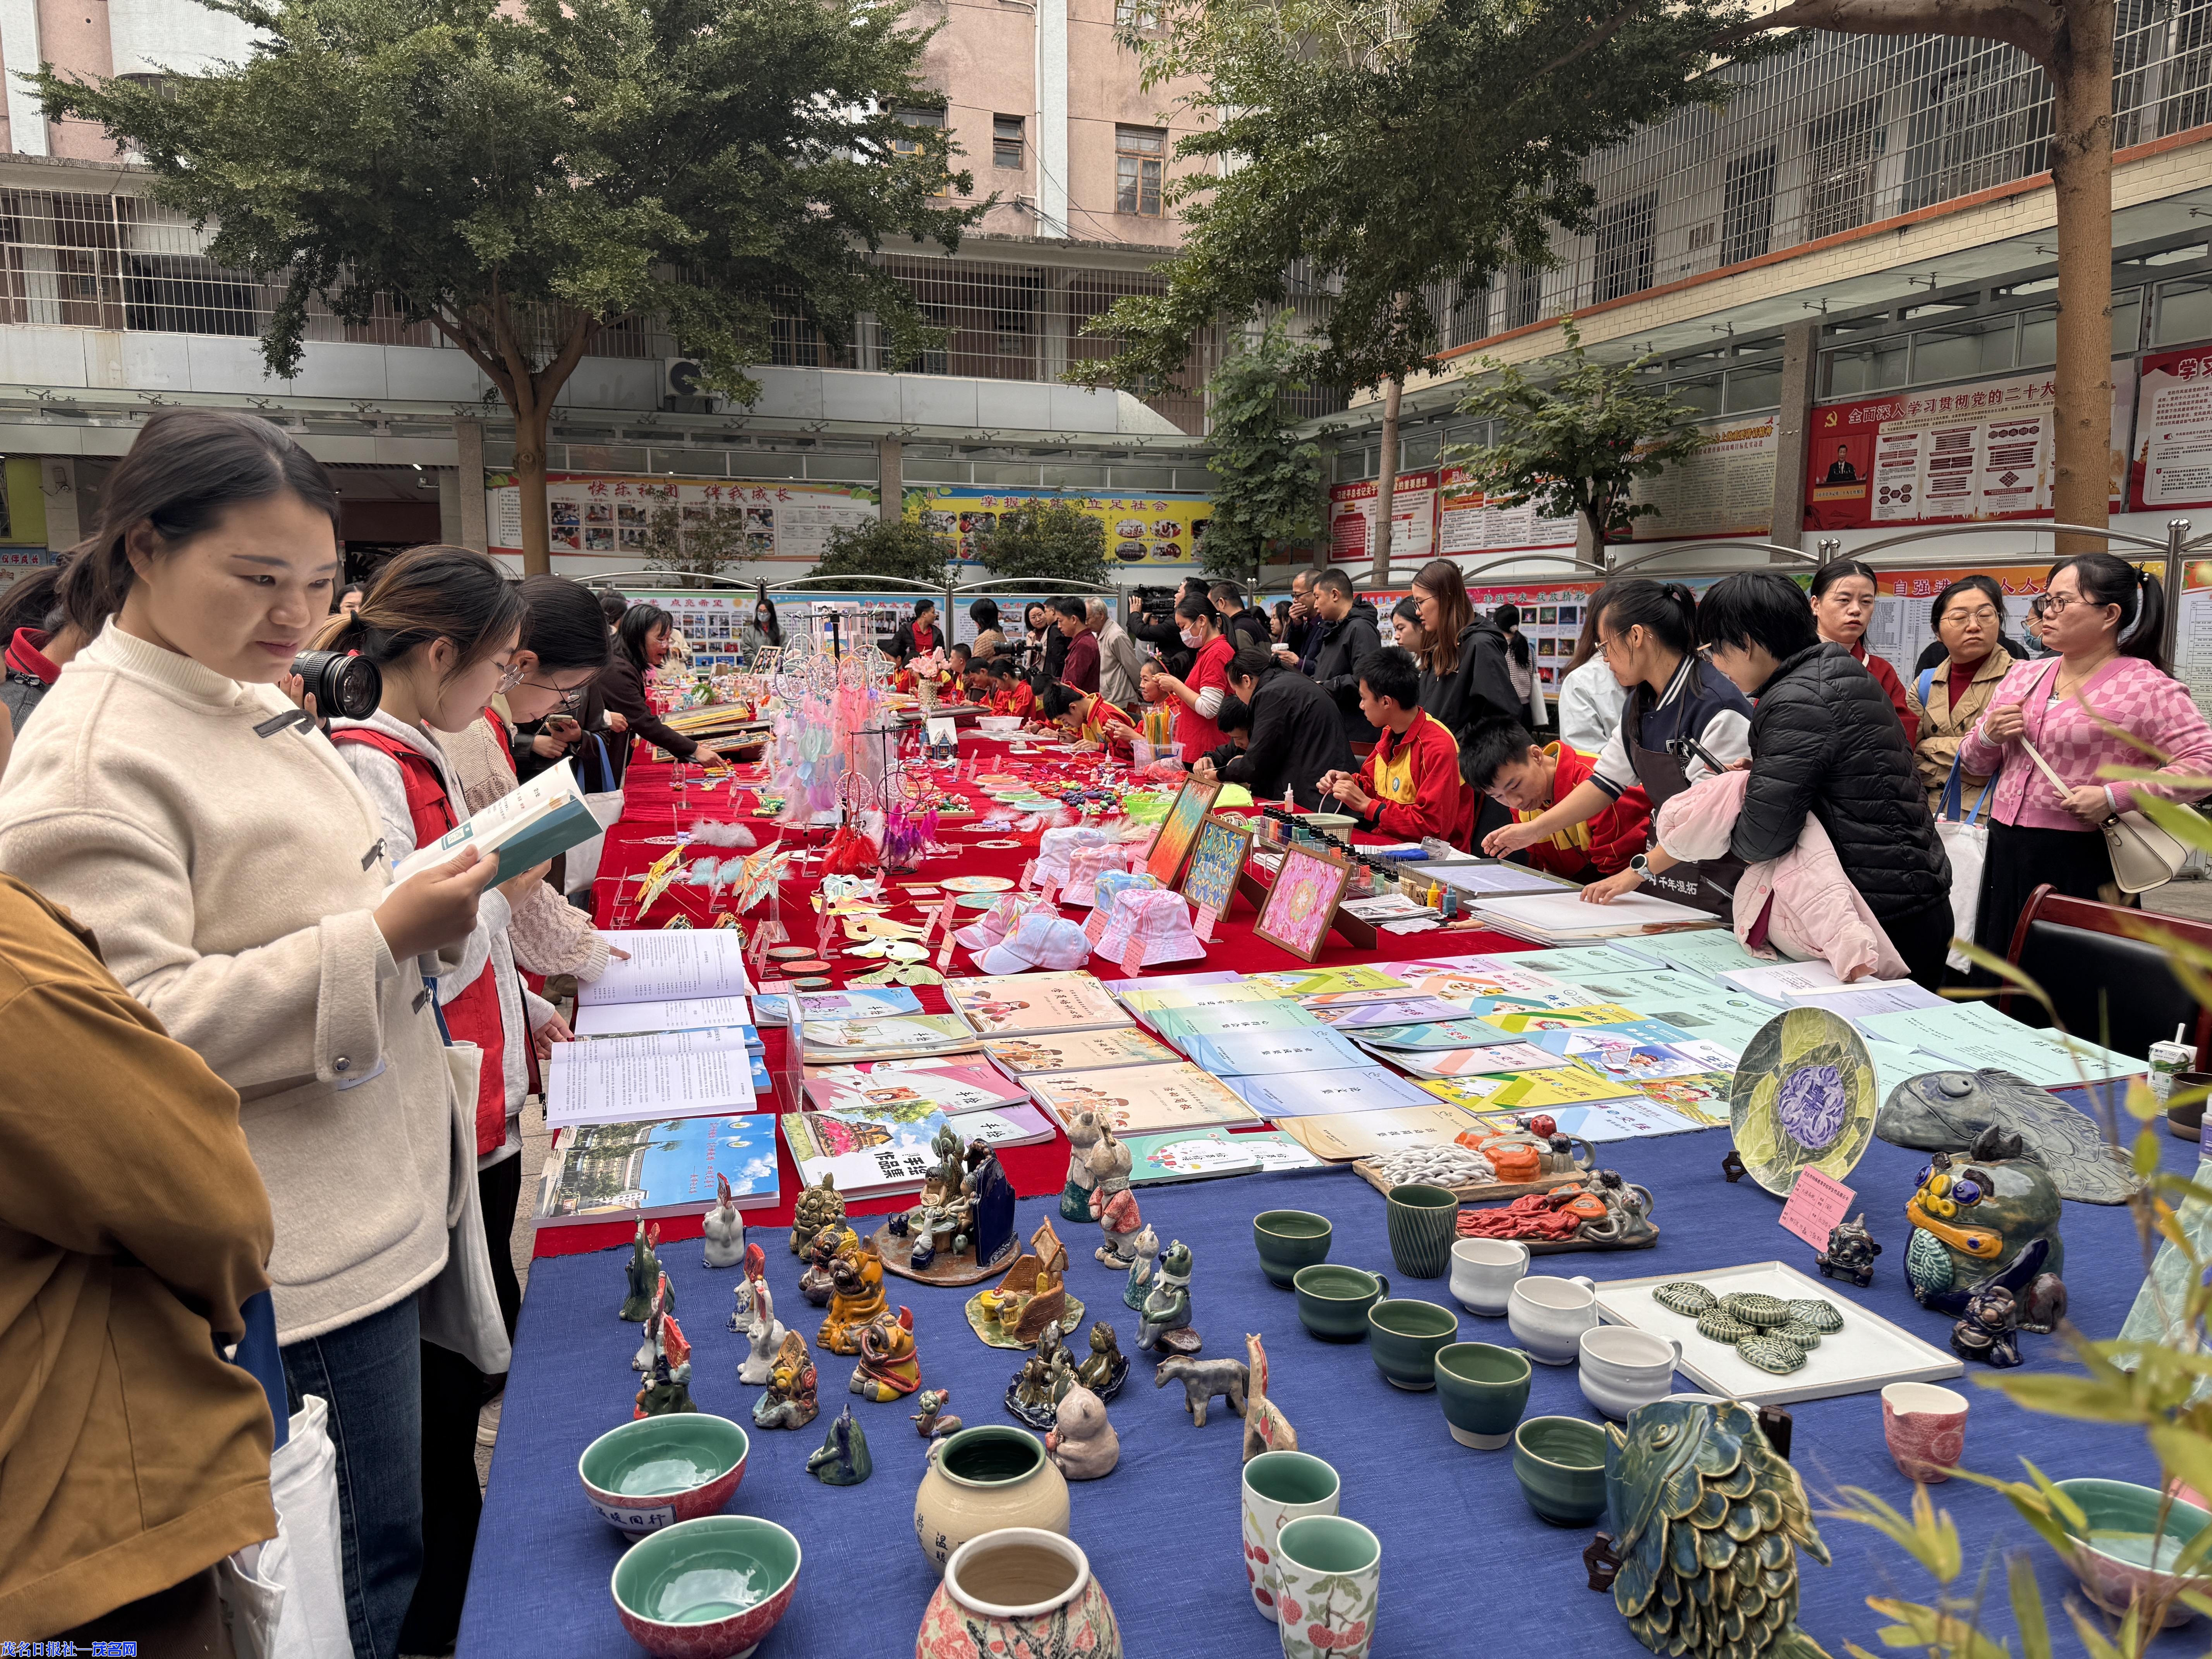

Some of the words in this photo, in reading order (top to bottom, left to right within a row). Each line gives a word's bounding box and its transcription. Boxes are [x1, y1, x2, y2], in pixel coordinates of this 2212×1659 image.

[1848, 381, 2055, 424] 全面深入学习贯彻党的二十大
[704, 483, 794, 503] 伴我成长
[1087, 498, 1169, 512] 立足社会
[671, 598, 724, 608] 点亮希望
[1699, 1055, 1737, 1070] 生活
[955, 1090, 984, 1104] 手绘
[874, 1150, 905, 1179] 作品集
[902, 1155, 928, 1176] 手绘
